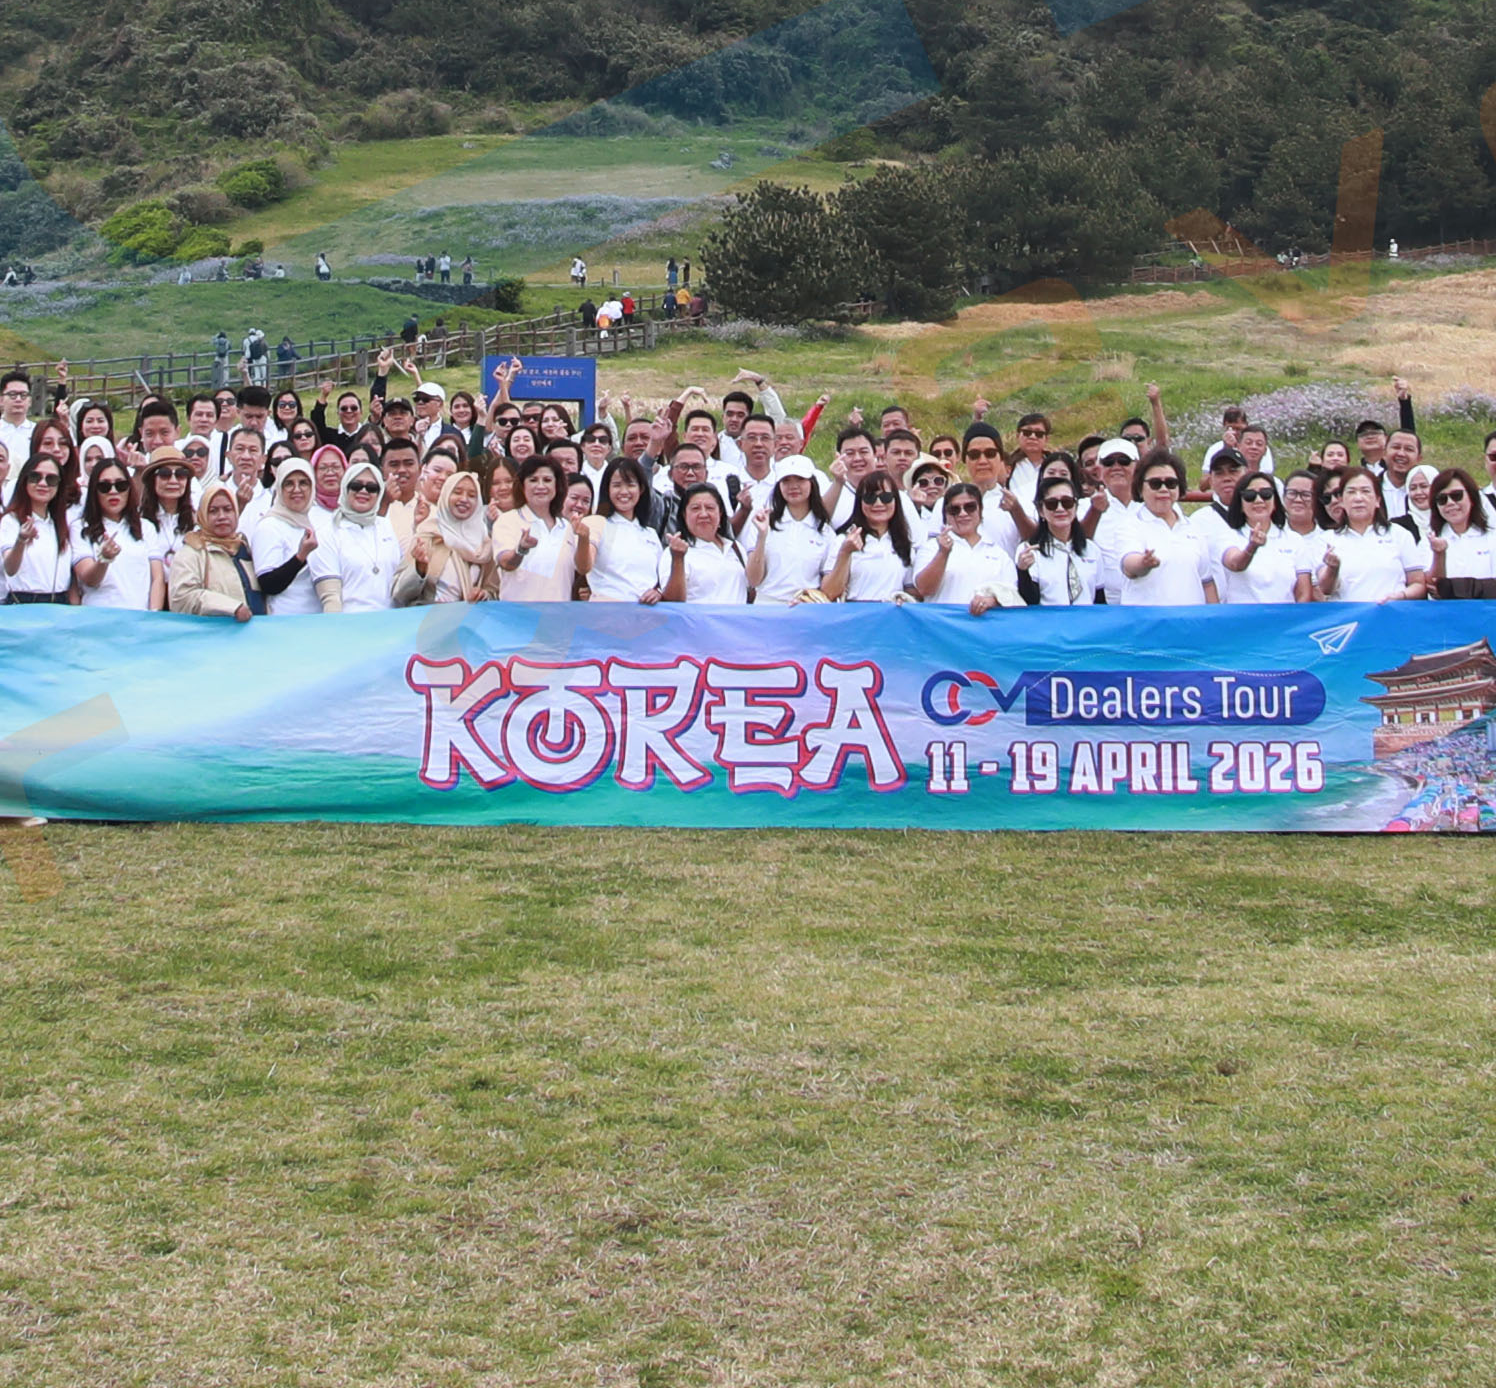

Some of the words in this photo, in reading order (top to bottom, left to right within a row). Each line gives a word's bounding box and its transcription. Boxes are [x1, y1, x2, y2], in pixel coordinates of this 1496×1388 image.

[1050, 676, 1202, 720] Dealers
[1212, 675, 1299, 719] Tour
[406, 655, 907, 798] KOREA
[925, 741, 970, 793] 11
[978, 759, 999, 775] -
[1008, 741, 1060, 793] 19
[1067, 741, 1201, 793] APRIL
[1207, 741, 1325, 794] 2026
